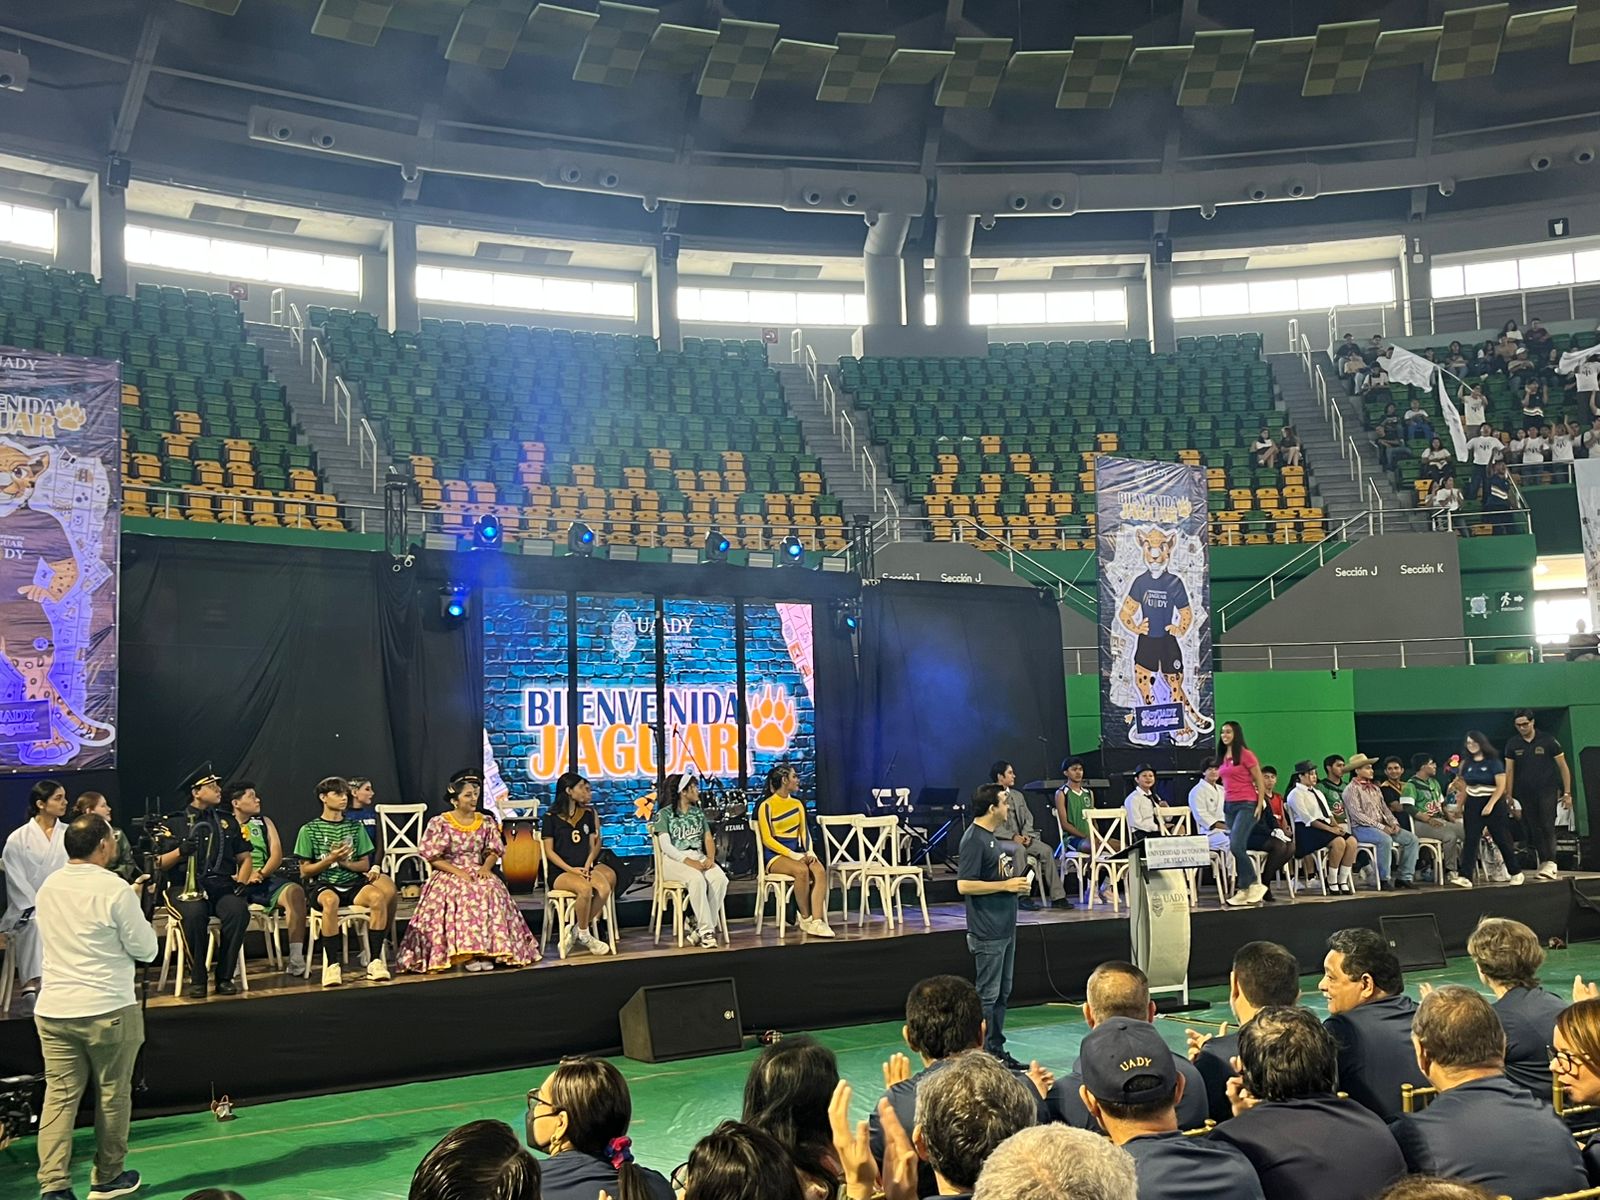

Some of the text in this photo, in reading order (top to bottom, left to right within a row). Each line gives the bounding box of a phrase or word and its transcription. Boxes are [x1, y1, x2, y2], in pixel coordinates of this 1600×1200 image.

[1335, 565, 1378, 577] Sección J
[1400, 563, 1444, 574] Sección K
[941, 573, 982, 583] Sección J
[637, 617, 694, 634] UADY
[528, 690, 751, 727] BIENVENIDA
[532, 723, 749, 777] JAGUAR
[571, 830, 581, 843] 6
[1162, 893, 1185, 903] UADY
[1120, 1056, 1152, 1071] UADY
